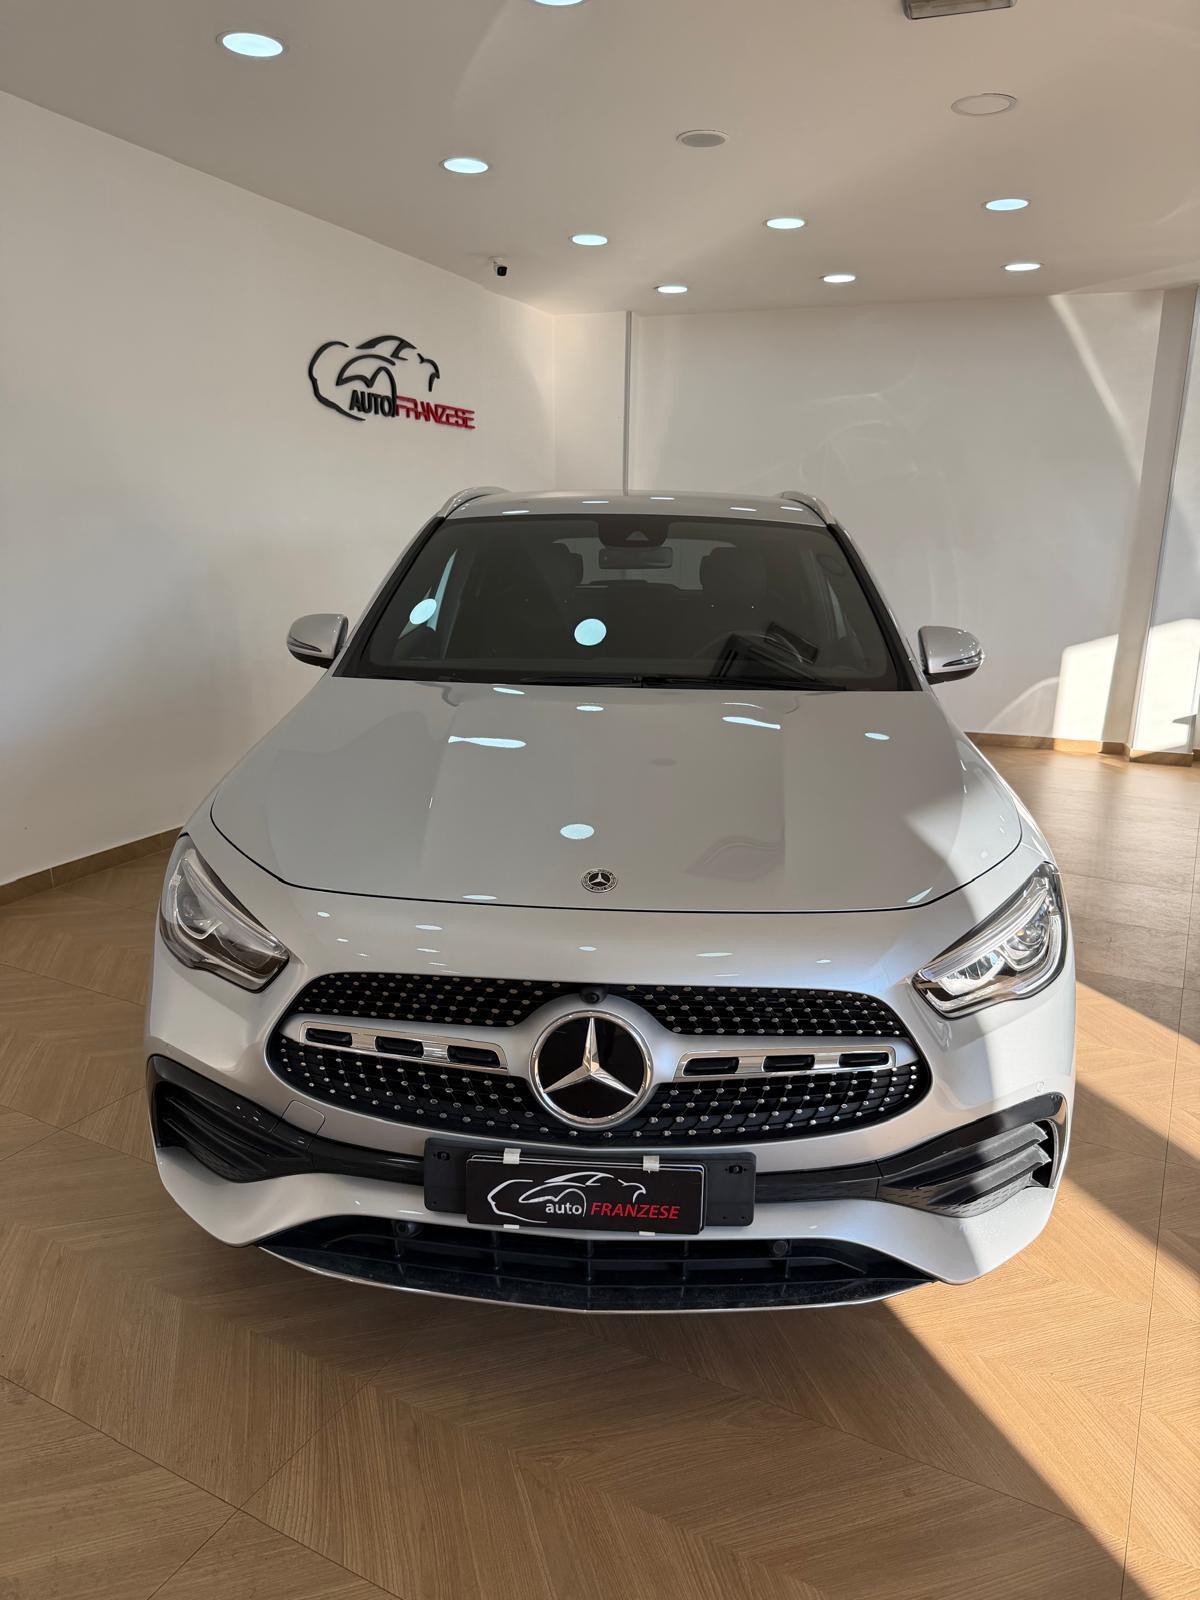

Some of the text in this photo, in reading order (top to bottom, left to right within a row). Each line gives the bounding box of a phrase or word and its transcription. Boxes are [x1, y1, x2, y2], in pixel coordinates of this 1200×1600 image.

[349, 390, 476, 430] AUTO FRANZESE
[545, 1202, 681, 1219] auto FRANZESE
